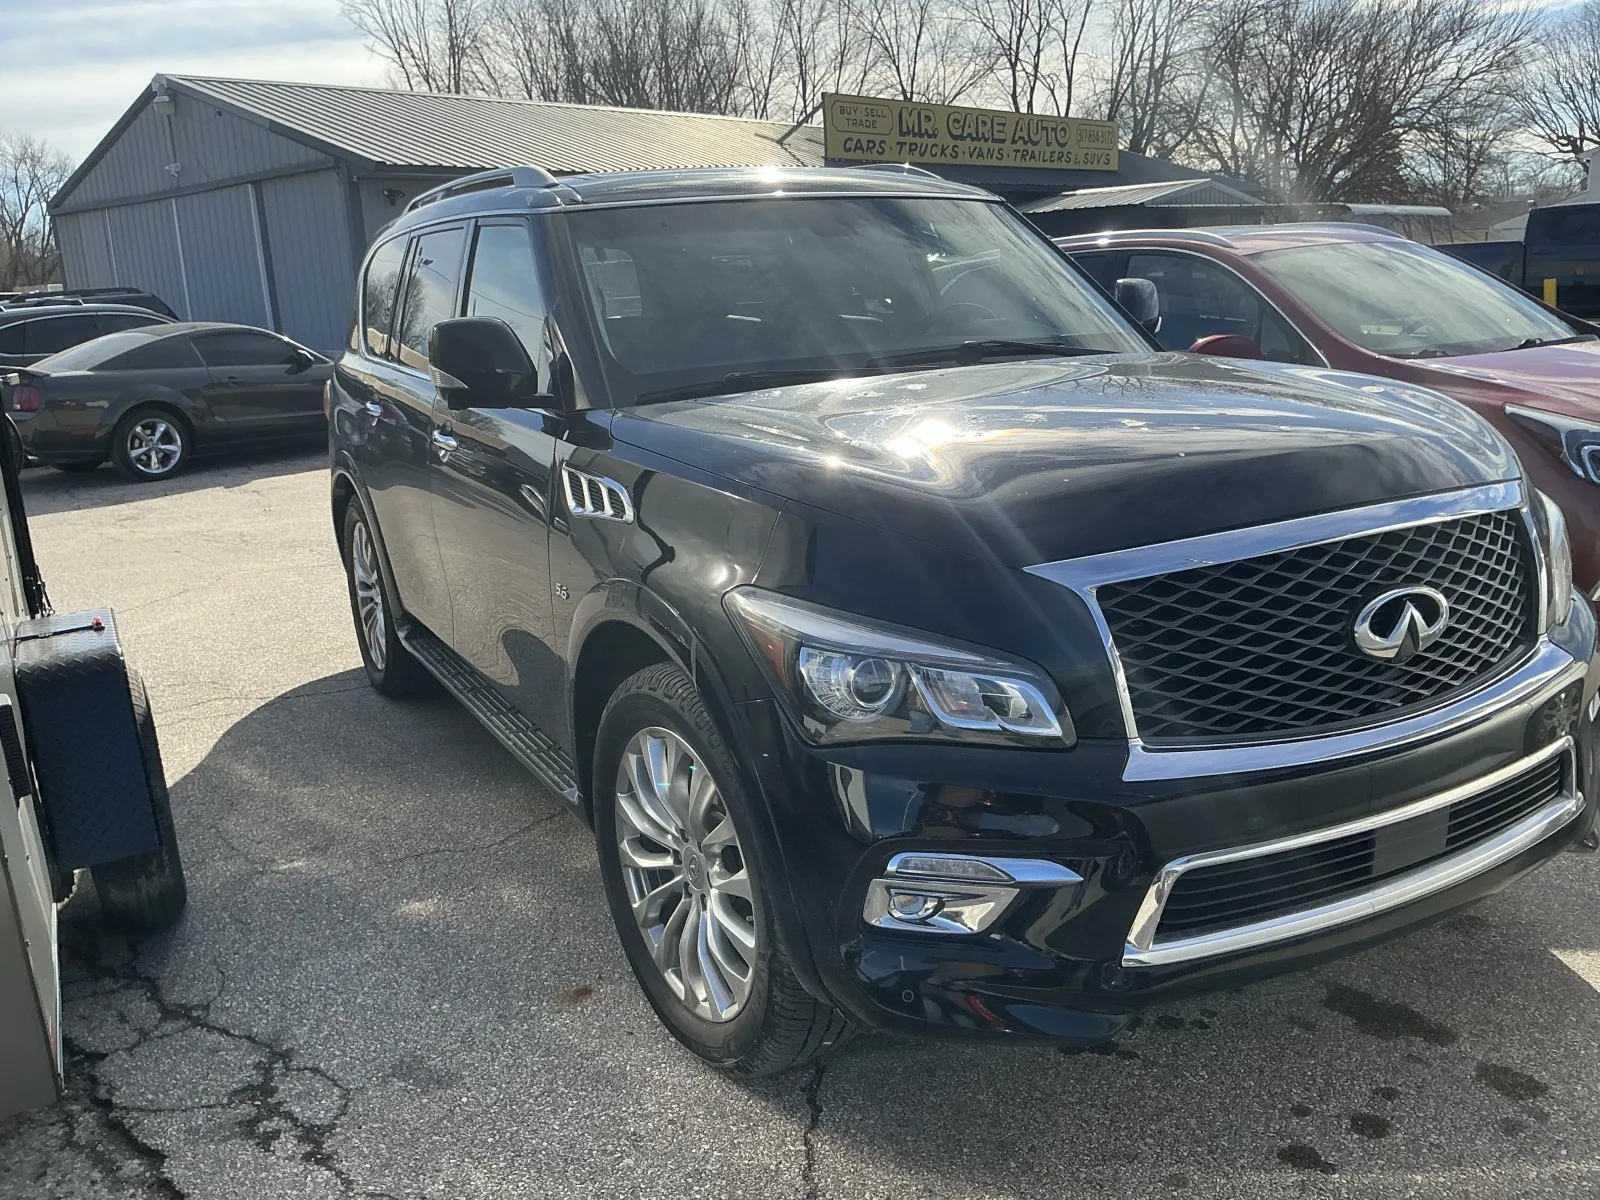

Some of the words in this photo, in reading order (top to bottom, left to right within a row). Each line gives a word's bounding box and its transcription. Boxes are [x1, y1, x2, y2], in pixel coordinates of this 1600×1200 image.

[839, 105, 859, 116] BUY
[864, 107, 887, 119] SELL
[845, 118, 878, 129] TRADE
[898, 106, 940, 140] MR.
[946, 111, 1008, 145] CARE
[1010, 117, 1071, 149] AUTO
[843, 136, 886, 156] CARS
[896, 141, 960, 160] TRUCKS
[968, 145, 1004, 161] VANS
[1012, 148, 1072, 164] TRAILERS
